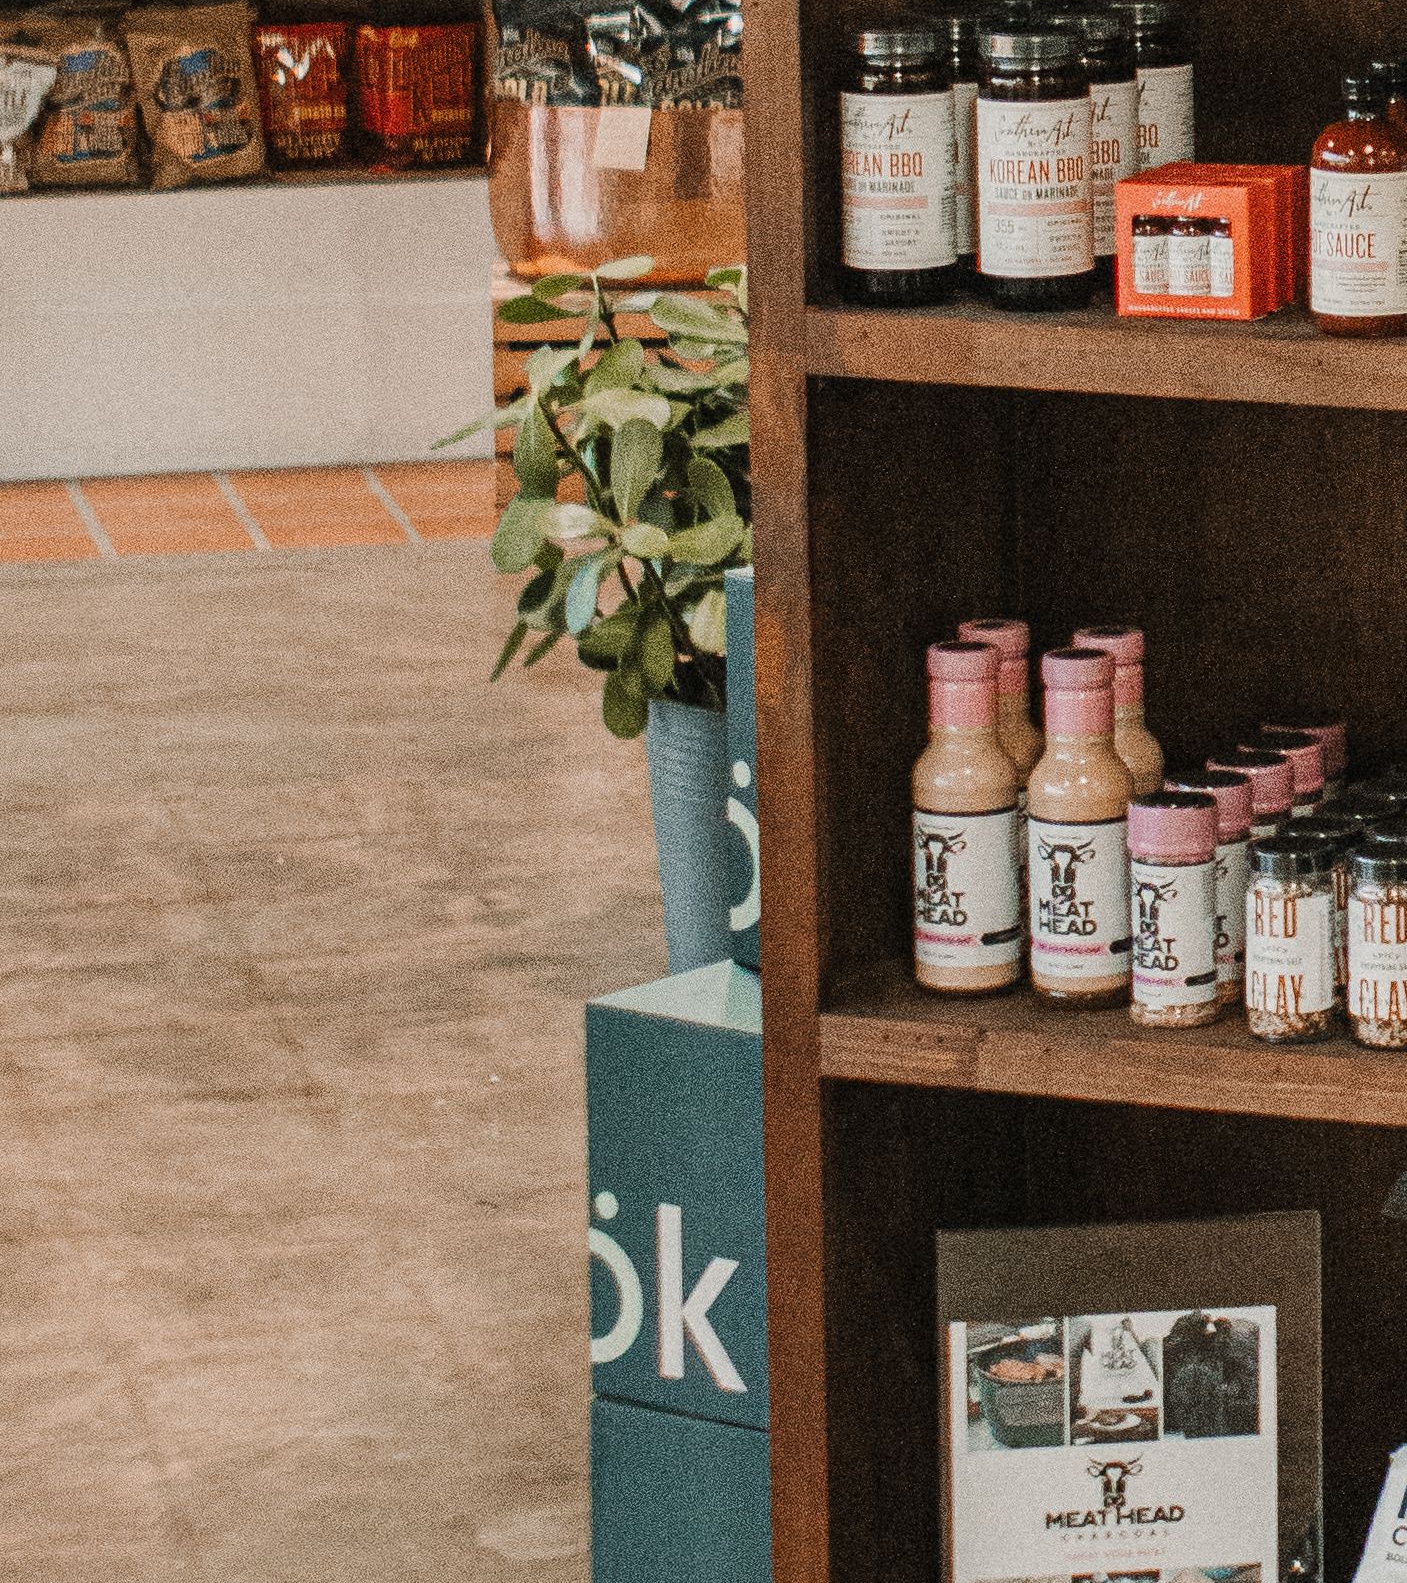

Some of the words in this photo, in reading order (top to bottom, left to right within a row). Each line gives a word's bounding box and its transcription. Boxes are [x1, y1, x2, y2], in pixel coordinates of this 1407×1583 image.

[889, 151, 924, 179] BBQ
[1090, 138, 1122, 165] BBQ
[989, 157, 1050, 185] KOREAN
[1055, 155, 1085, 182] BBQ
[1326, 232, 1377, 260] SAUCE
[1038, 897, 1096, 919] MEAT
[1254, 891, 1298, 939] RED
[1038, 917, 1098, 936] HEAD
[1249, 970, 1304, 1017] CLAY
[1045, 1508, 1110, 1530] MEAT
[1115, 1504, 1186, 1526] HEAD
